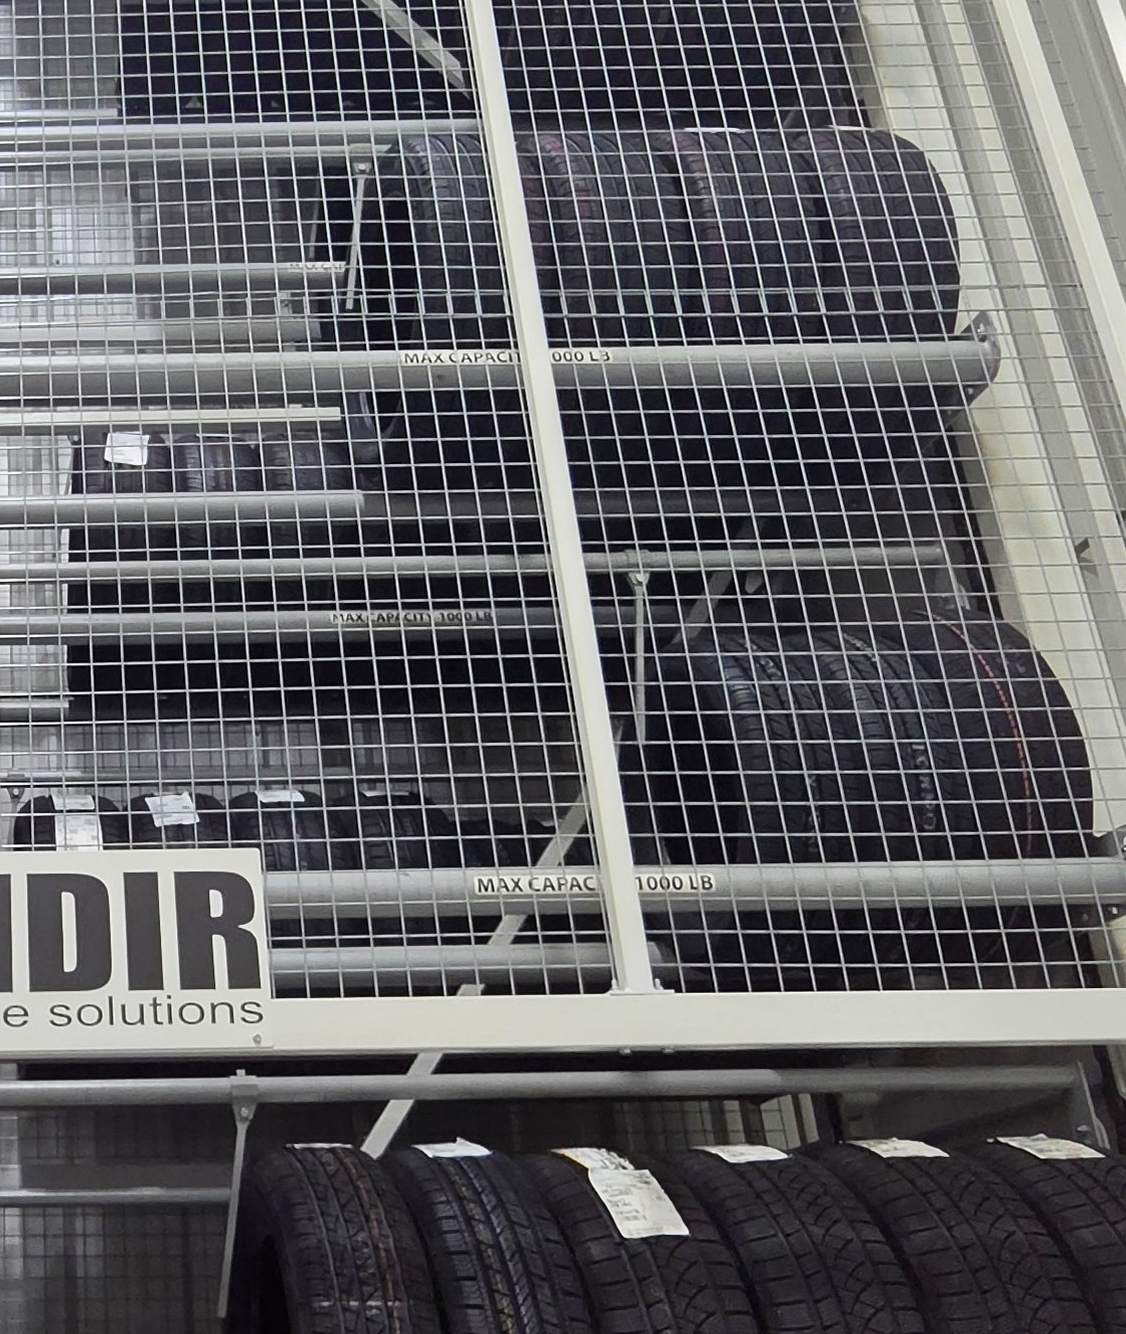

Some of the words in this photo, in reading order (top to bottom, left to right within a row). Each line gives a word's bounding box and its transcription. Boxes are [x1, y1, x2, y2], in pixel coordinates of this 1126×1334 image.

[404, 352, 445, 364] MAX
[477, 876, 524, 893] MAX
[528, 876, 597, 892] CAPAC
[636, 875, 683, 891] 1000
[689, 874, 714, 890] LB
[49, 993, 265, 1028] solutions
